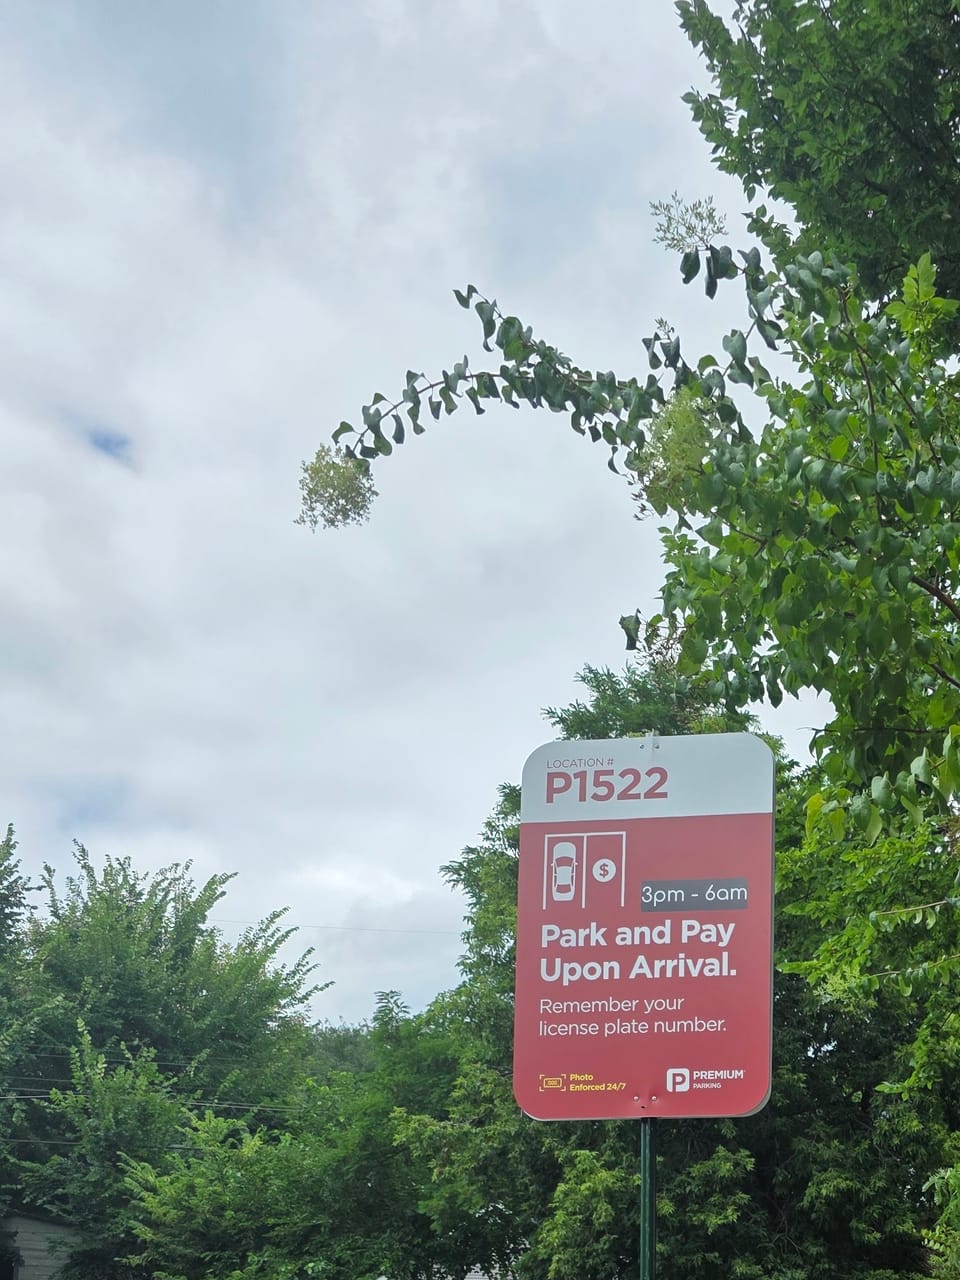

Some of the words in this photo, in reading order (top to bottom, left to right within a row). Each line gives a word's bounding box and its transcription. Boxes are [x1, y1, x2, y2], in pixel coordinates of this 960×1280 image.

[547, 758, 604, 769] LOCATION
[606, 758, 614, 766] #
[546, 766, 668, 804] P1522
[642, 886, 684, 904] 3pm
[705, 884, 748, 902] 6am
[542, 922, 607, 948] Park
[616, 920, 670, 945] and
[682, 920, 736, 947] Pay
[540, 958, 620, 986] Upon
[629, 952, 736, 979] Arrival.
[540, 996, 638, 1014] Remember
[643, 997, 684, 1014] your
[539, 1019, 599, 1036] license
[604, 1018, 648, 1038] plate
[654, 1016, 726, 1034] number.
[570, 1073, 594, 1081] Photo
[693, 1070, 744, 1080] PREMIUM
[570, 1083, 605, 1092] Enforced
[606, 1082, 626, 1090] 24/7
